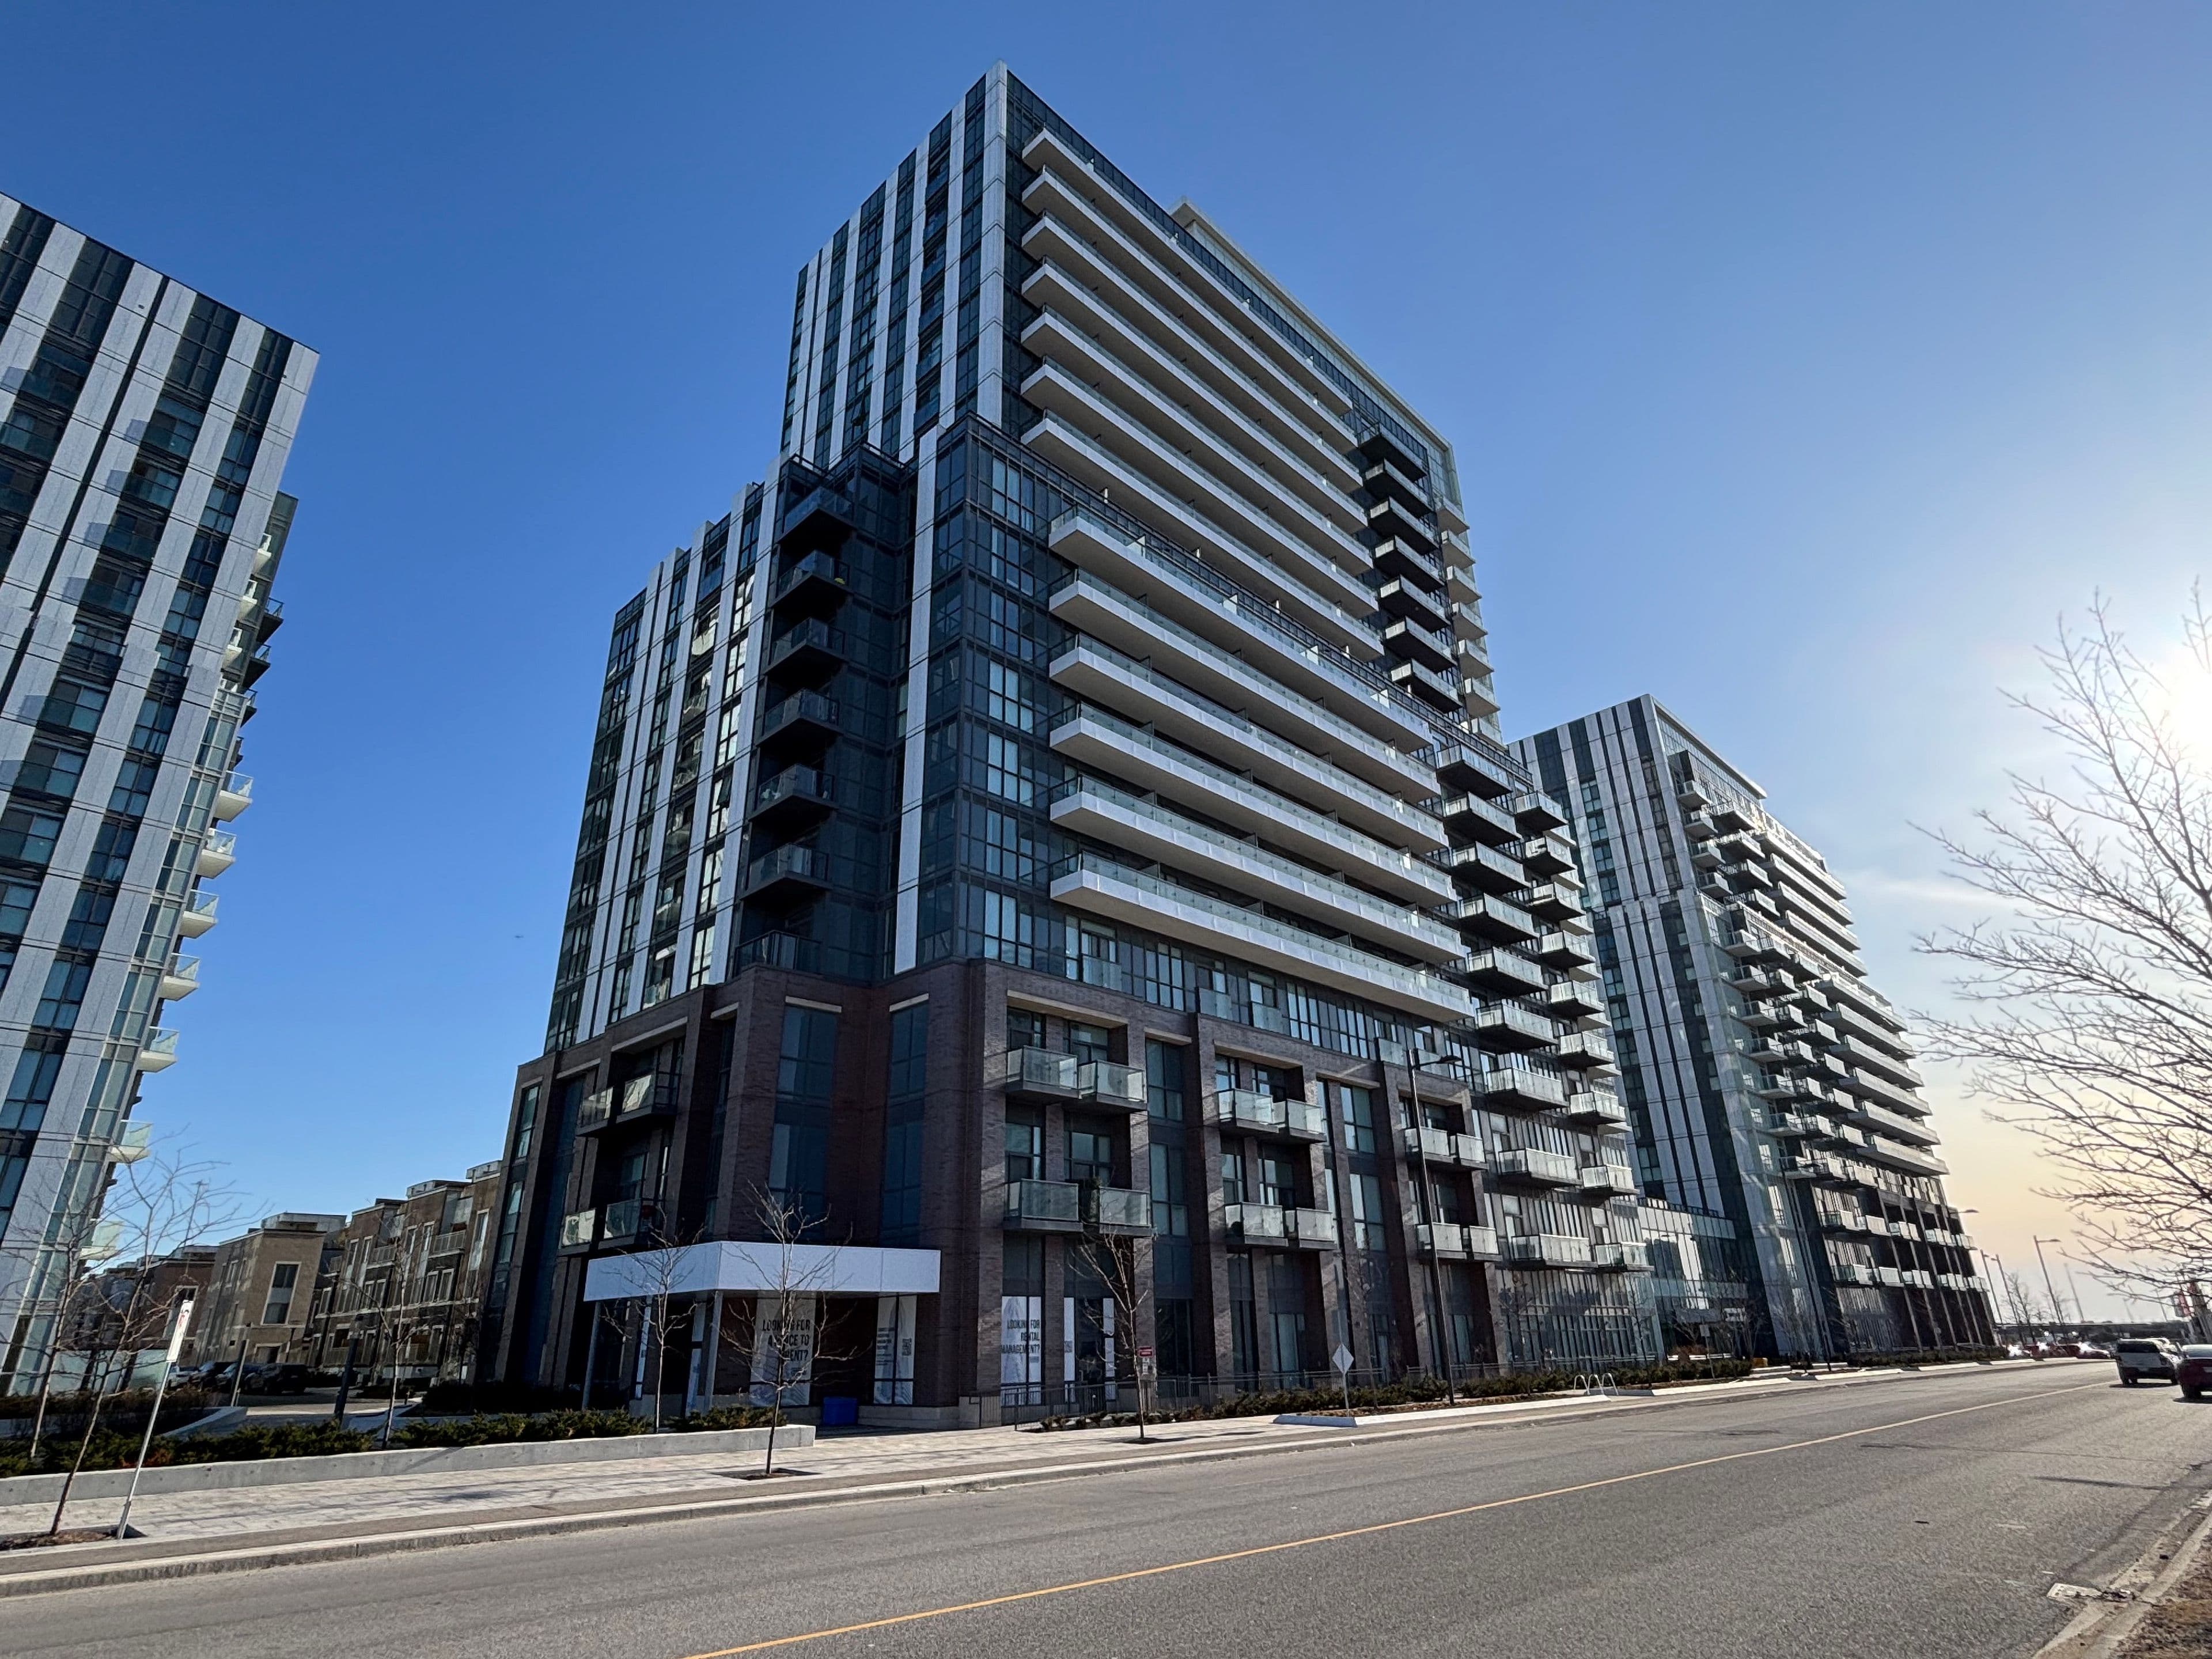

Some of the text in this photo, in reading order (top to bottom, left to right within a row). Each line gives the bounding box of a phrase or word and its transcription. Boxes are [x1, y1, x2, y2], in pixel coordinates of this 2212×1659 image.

[763, 1319, 810, 1331] LOOKG FOR
[1007, 1319, 1040, 1330] LOOKIN FOR
[774, 1334, 798, 1346] PACE
[800, 1334, 809, 1346] TO
[1001, 1344, 1040, 1354] MANAGEMNT?
